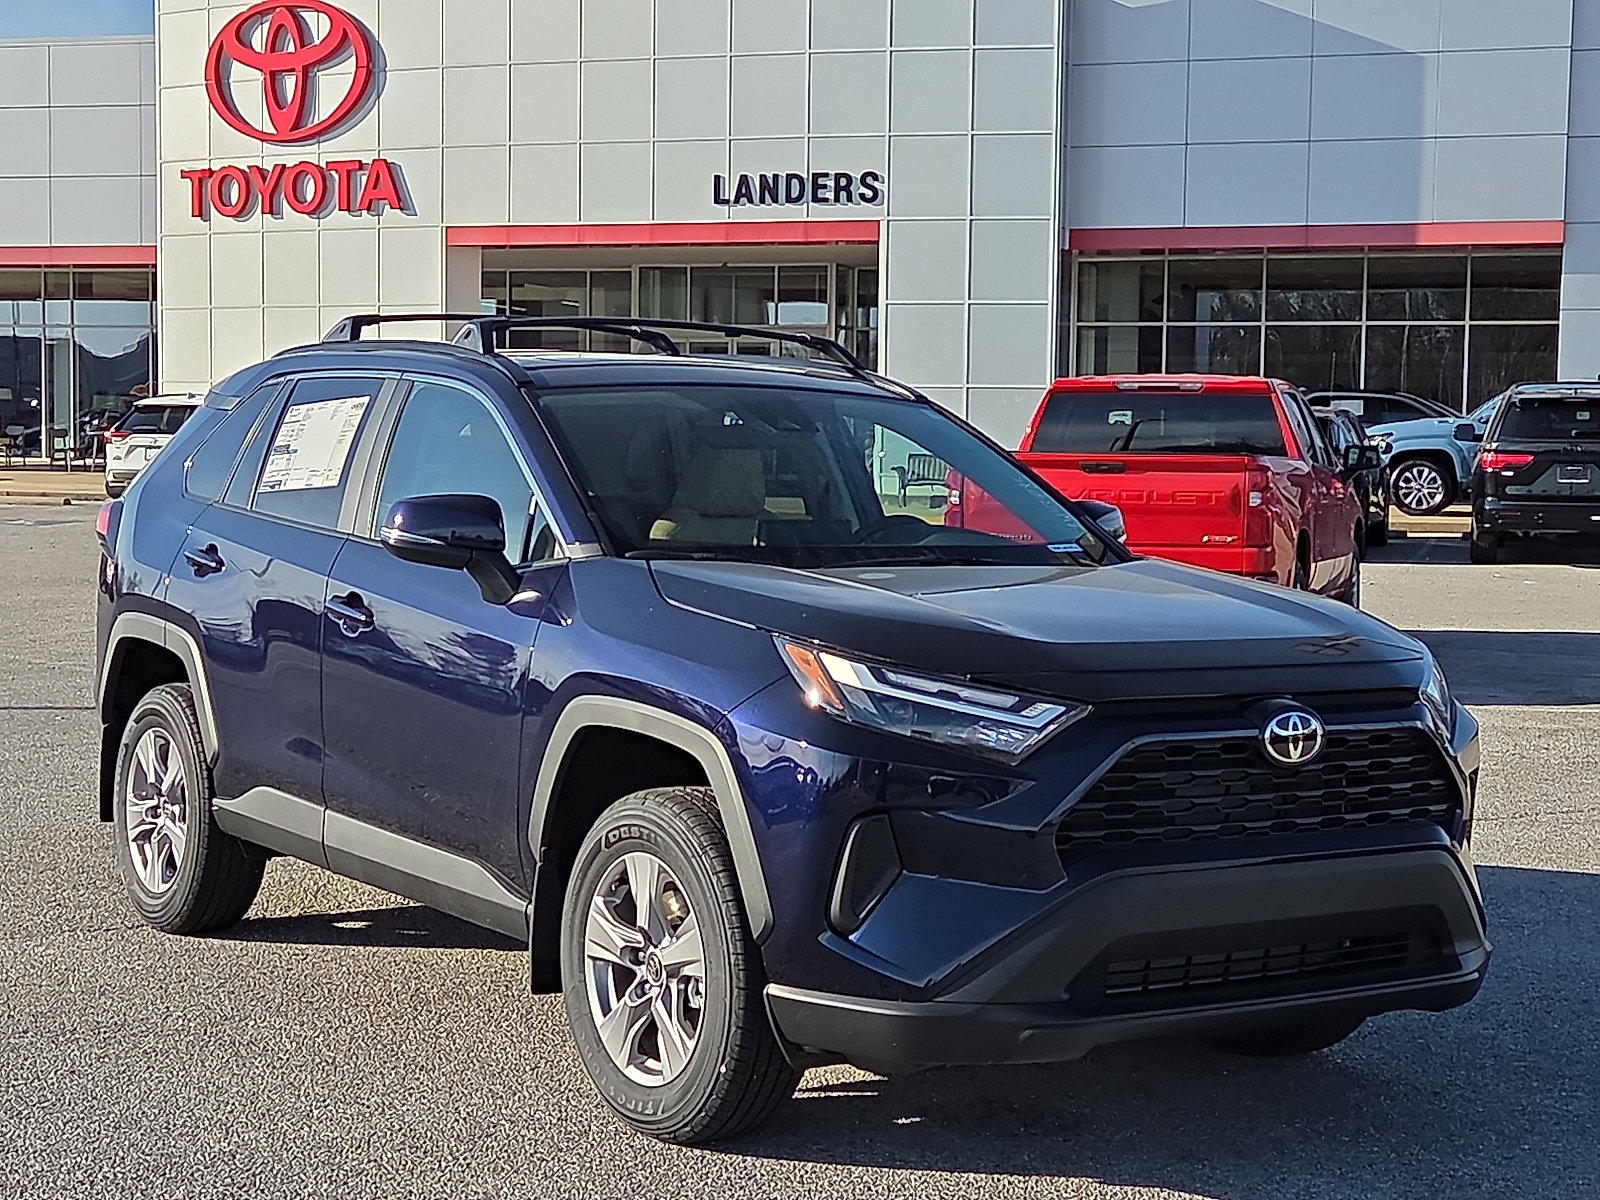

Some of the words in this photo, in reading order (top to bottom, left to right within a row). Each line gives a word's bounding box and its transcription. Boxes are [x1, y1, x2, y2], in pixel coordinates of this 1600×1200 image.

[181, 159, 403, 217] TOYOTA
[713, 171, 881, 205] LANDERS
[1061, 488, 1225, 506] VROLET
